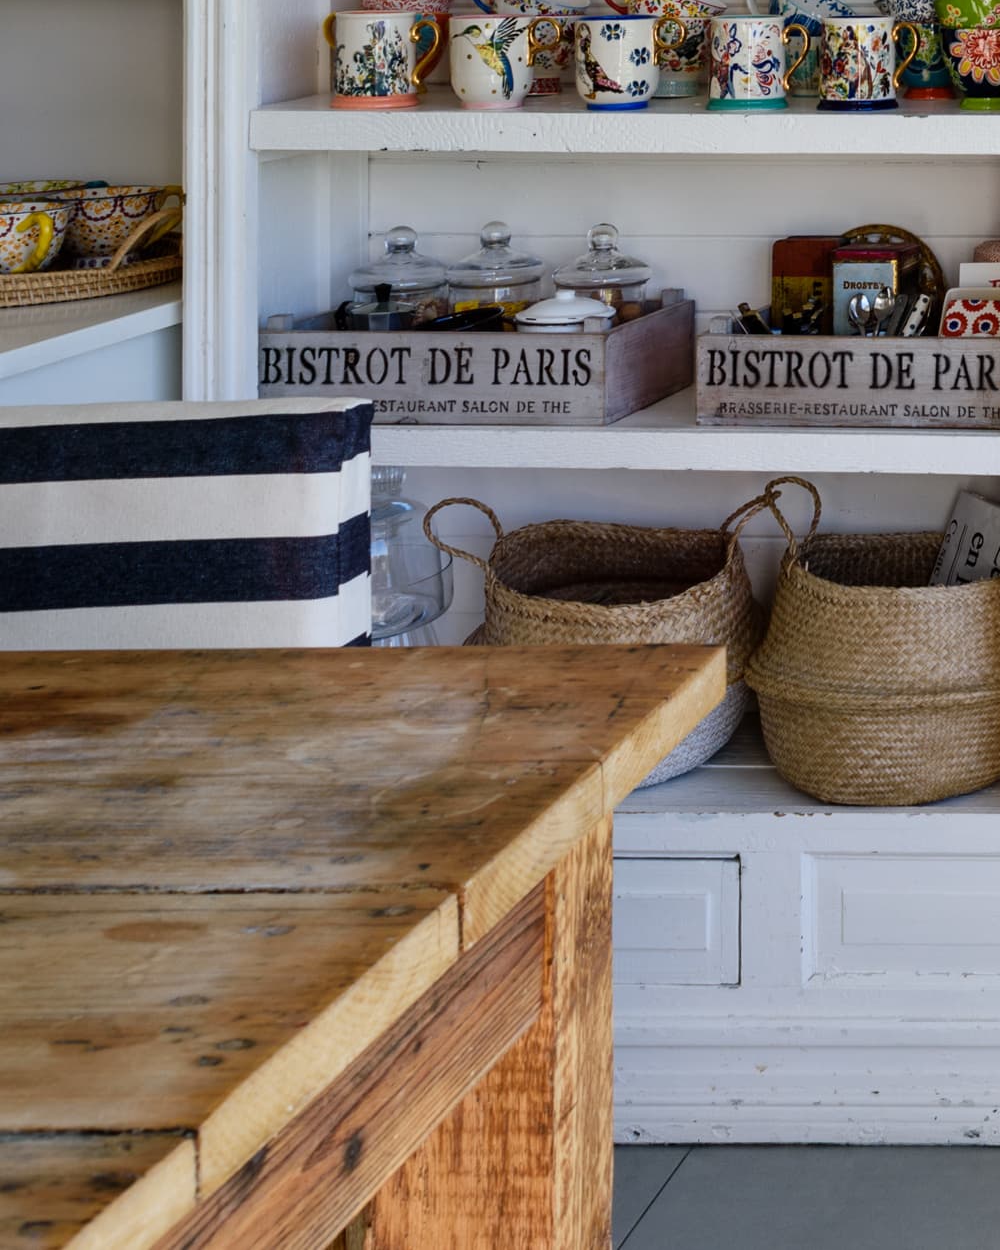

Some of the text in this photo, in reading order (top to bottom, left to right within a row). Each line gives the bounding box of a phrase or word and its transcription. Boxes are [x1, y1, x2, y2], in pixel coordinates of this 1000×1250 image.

[261, 347, 592, 386] BISTROT DE PARIS
[705, 349, 853, 389] BISTROT
[869, 352, 915, 391] DE
[462, 401, 509, 414] SALON
[516, 402, 535, 414] DE
[542, 402, 571, 414] THE
[718, 402, 898, 418] BRASSERIE-RESTAURANT
[903, 404, 950, 418] SALON
[957, 406, 976, 419] DE
[965, 532, 984, 568] en
